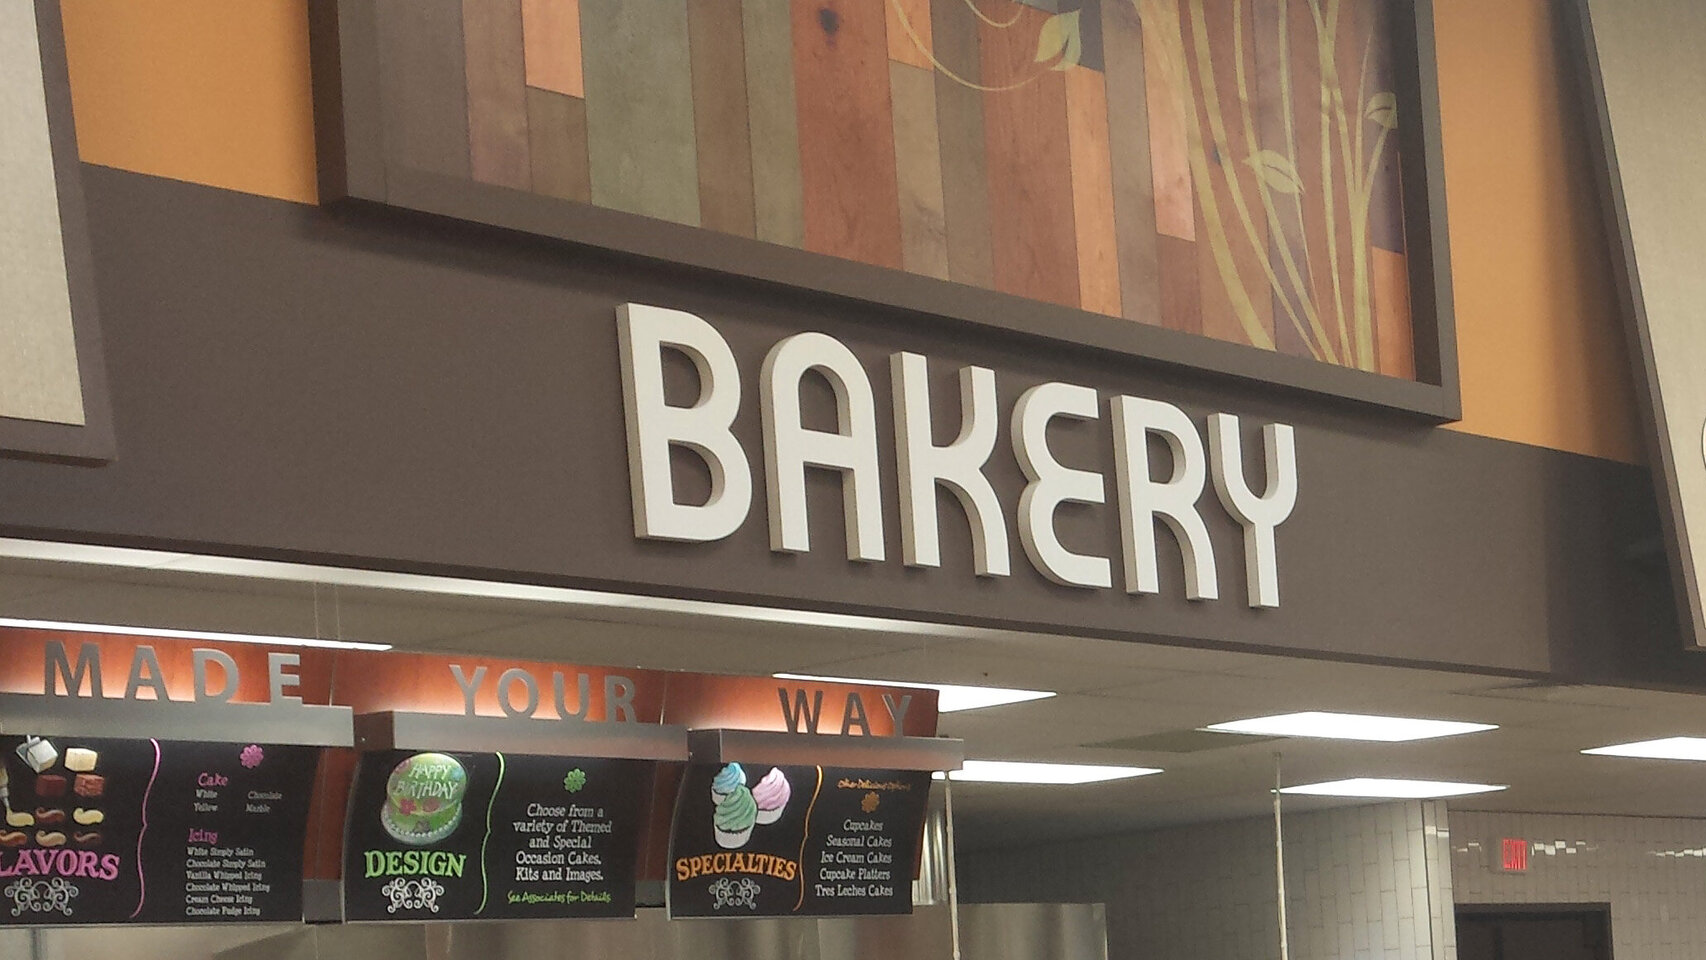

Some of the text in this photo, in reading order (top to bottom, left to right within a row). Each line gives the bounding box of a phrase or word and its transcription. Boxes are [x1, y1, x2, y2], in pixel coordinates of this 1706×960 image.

[616, 302, 1299, 608] BAKERY
[45, 640, 911, 738] MADE YOUR WAY
[409, 764, 452, 778] HAPPY
[198, 772, 229, 787] Cake
[394, 780, 458, 799] BIRTHDAY
[526, 803, 604, 819] Choose from a
[512, 820, 612, 835] variety of Themed
[843, 819, 883, 832] Cupcakes
[188, 828, 218, 845] Icing
[529, 836, 592, 850] and Special
[826, 835, 892, 848] Seasonal Cakes
[515, 851, 565, 865] Occasion
[820, 851, 892, 864] Ice Cream Cakes
[1503, 838, 1528, 871] EXIT
[0, 848, 120, 881] LAVORS
[364, 850, 467, 879] DESIGN
[675, 852, 798, 882] SPECIALTIES
[515, 867, 539, 881] Kits
[542, 867, 563, 881] and
[819, 867, 890, 882] Cupcake Platters
[507, 890, 520, 904] See
[566, 890, 580, 904] for
[581, 890, 611, 903] Details
[815, 883, 893, 897] Tres Leches Cakes
